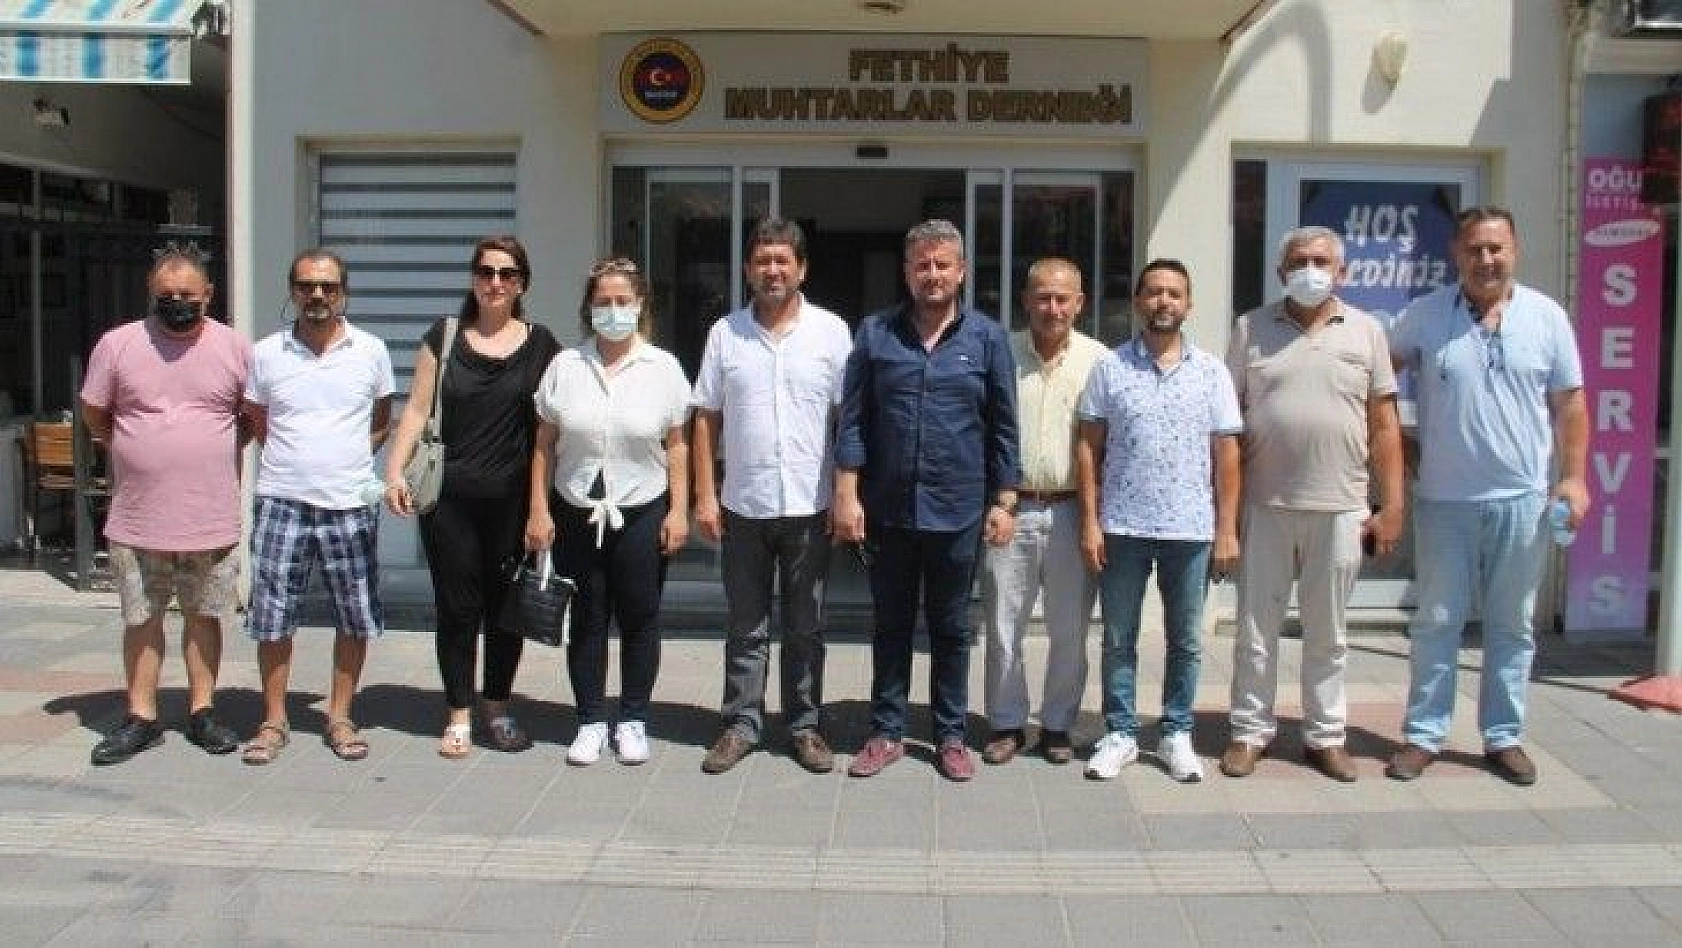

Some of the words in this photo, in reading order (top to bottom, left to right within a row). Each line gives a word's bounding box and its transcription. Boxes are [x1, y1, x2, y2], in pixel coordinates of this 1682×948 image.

[848, 43, 1010, 82] FETHİYE
[725, 87, 957, 121] MUHTARLAR
[967, 83, 1133, 123] DERNEĞİ
[1588, 165, 1643, 191] OĞU
[1345, 205, 1418, 252] HOŞ
[1344, 253, 1447, 287] LDİNİZ
[1586, 264, 1638, 611] SERVİS
